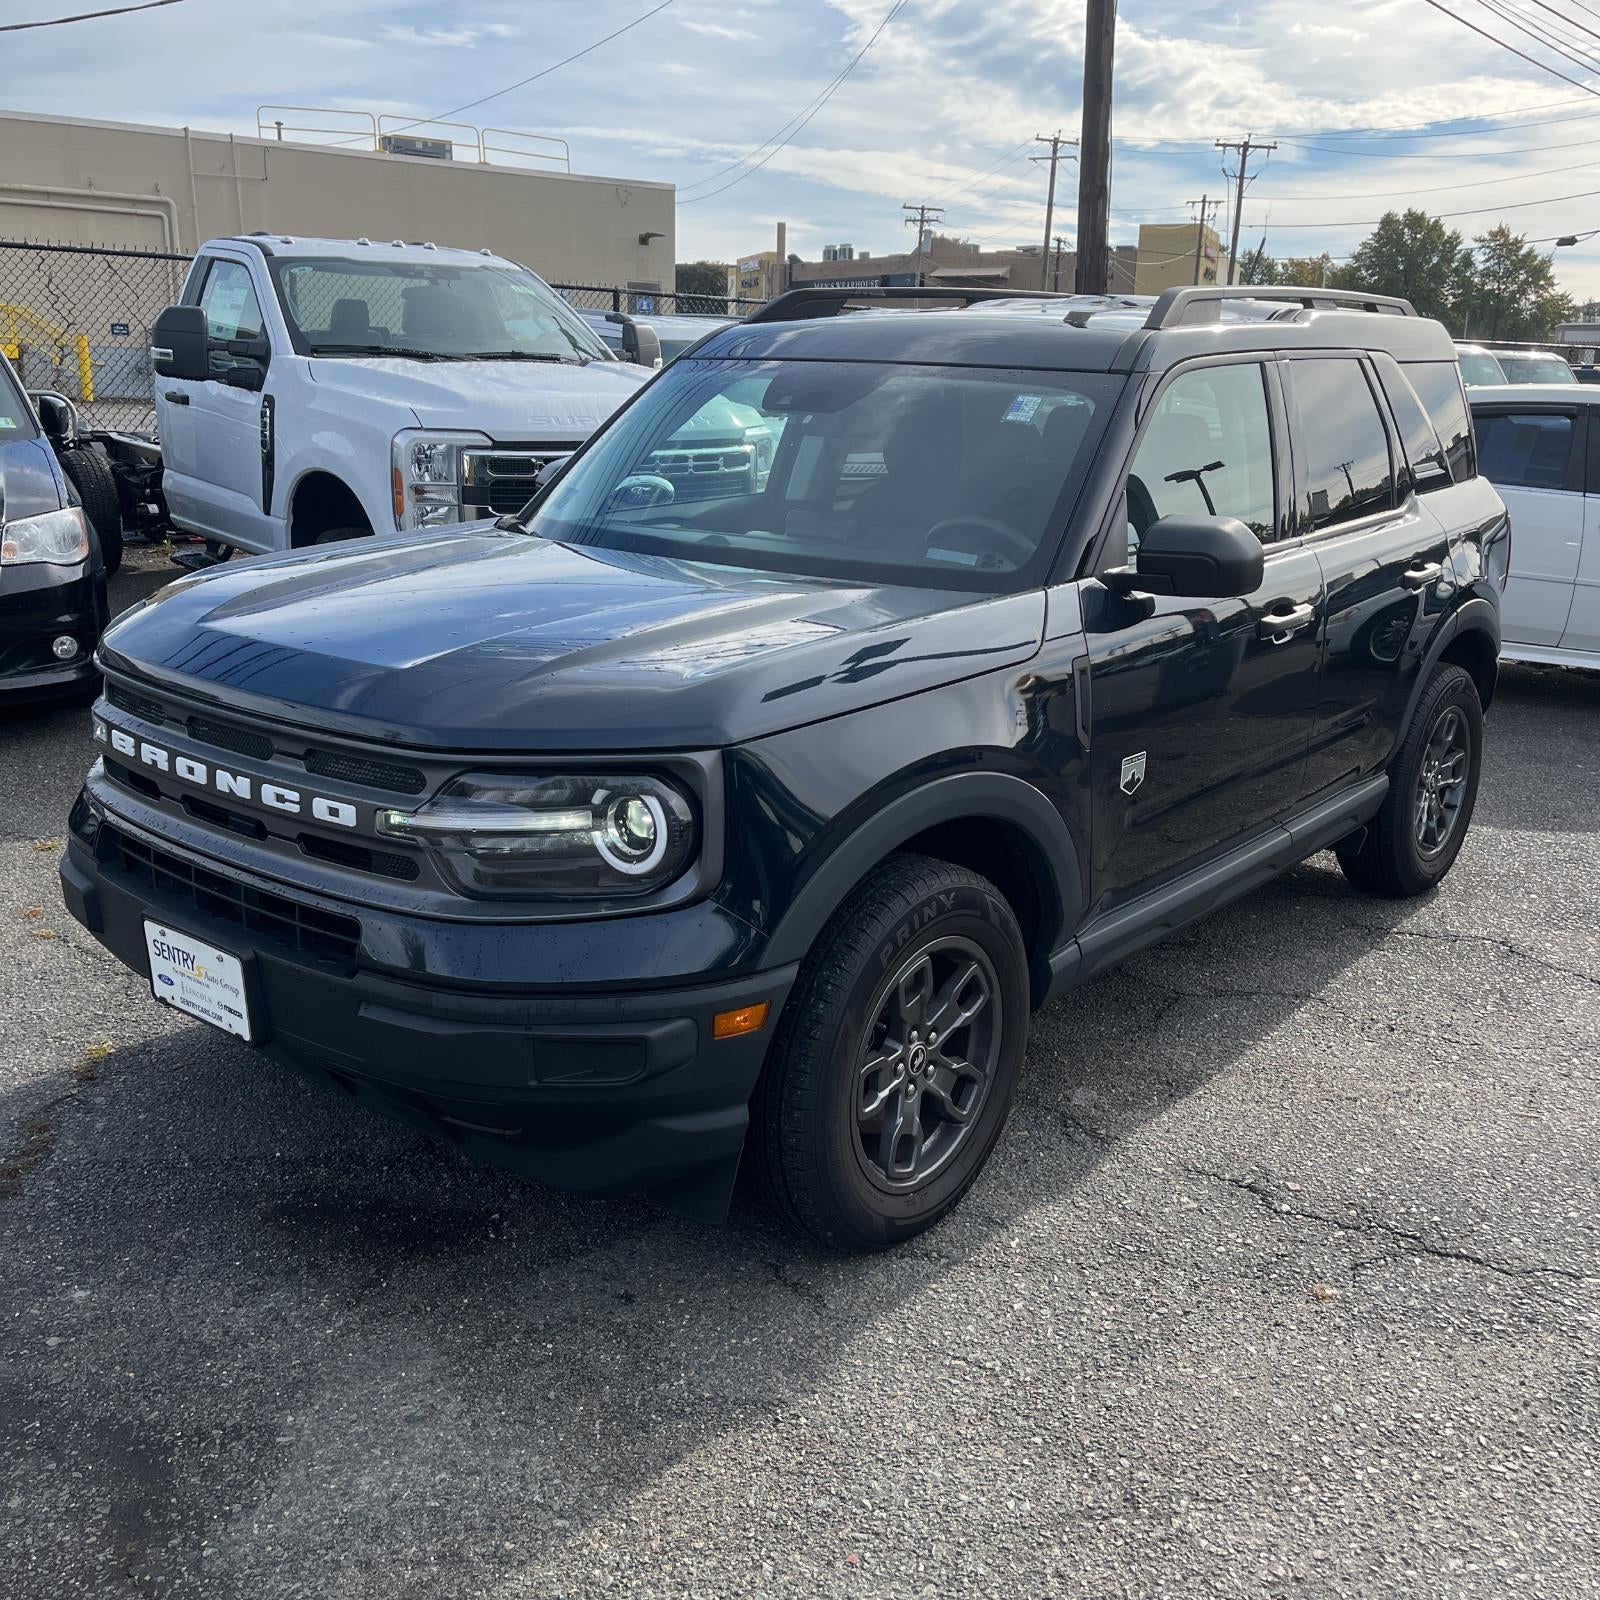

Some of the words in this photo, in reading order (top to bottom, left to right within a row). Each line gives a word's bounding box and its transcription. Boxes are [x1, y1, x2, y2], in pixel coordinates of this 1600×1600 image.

[835, 279, 880, 288] WEARHOUSE
[111, 729, 357, 827] BRONCO
[152, 938, 196, 971] SENTRY
[203, 971, 220, 985] Auto
[219, 977, 240, 998] Group
